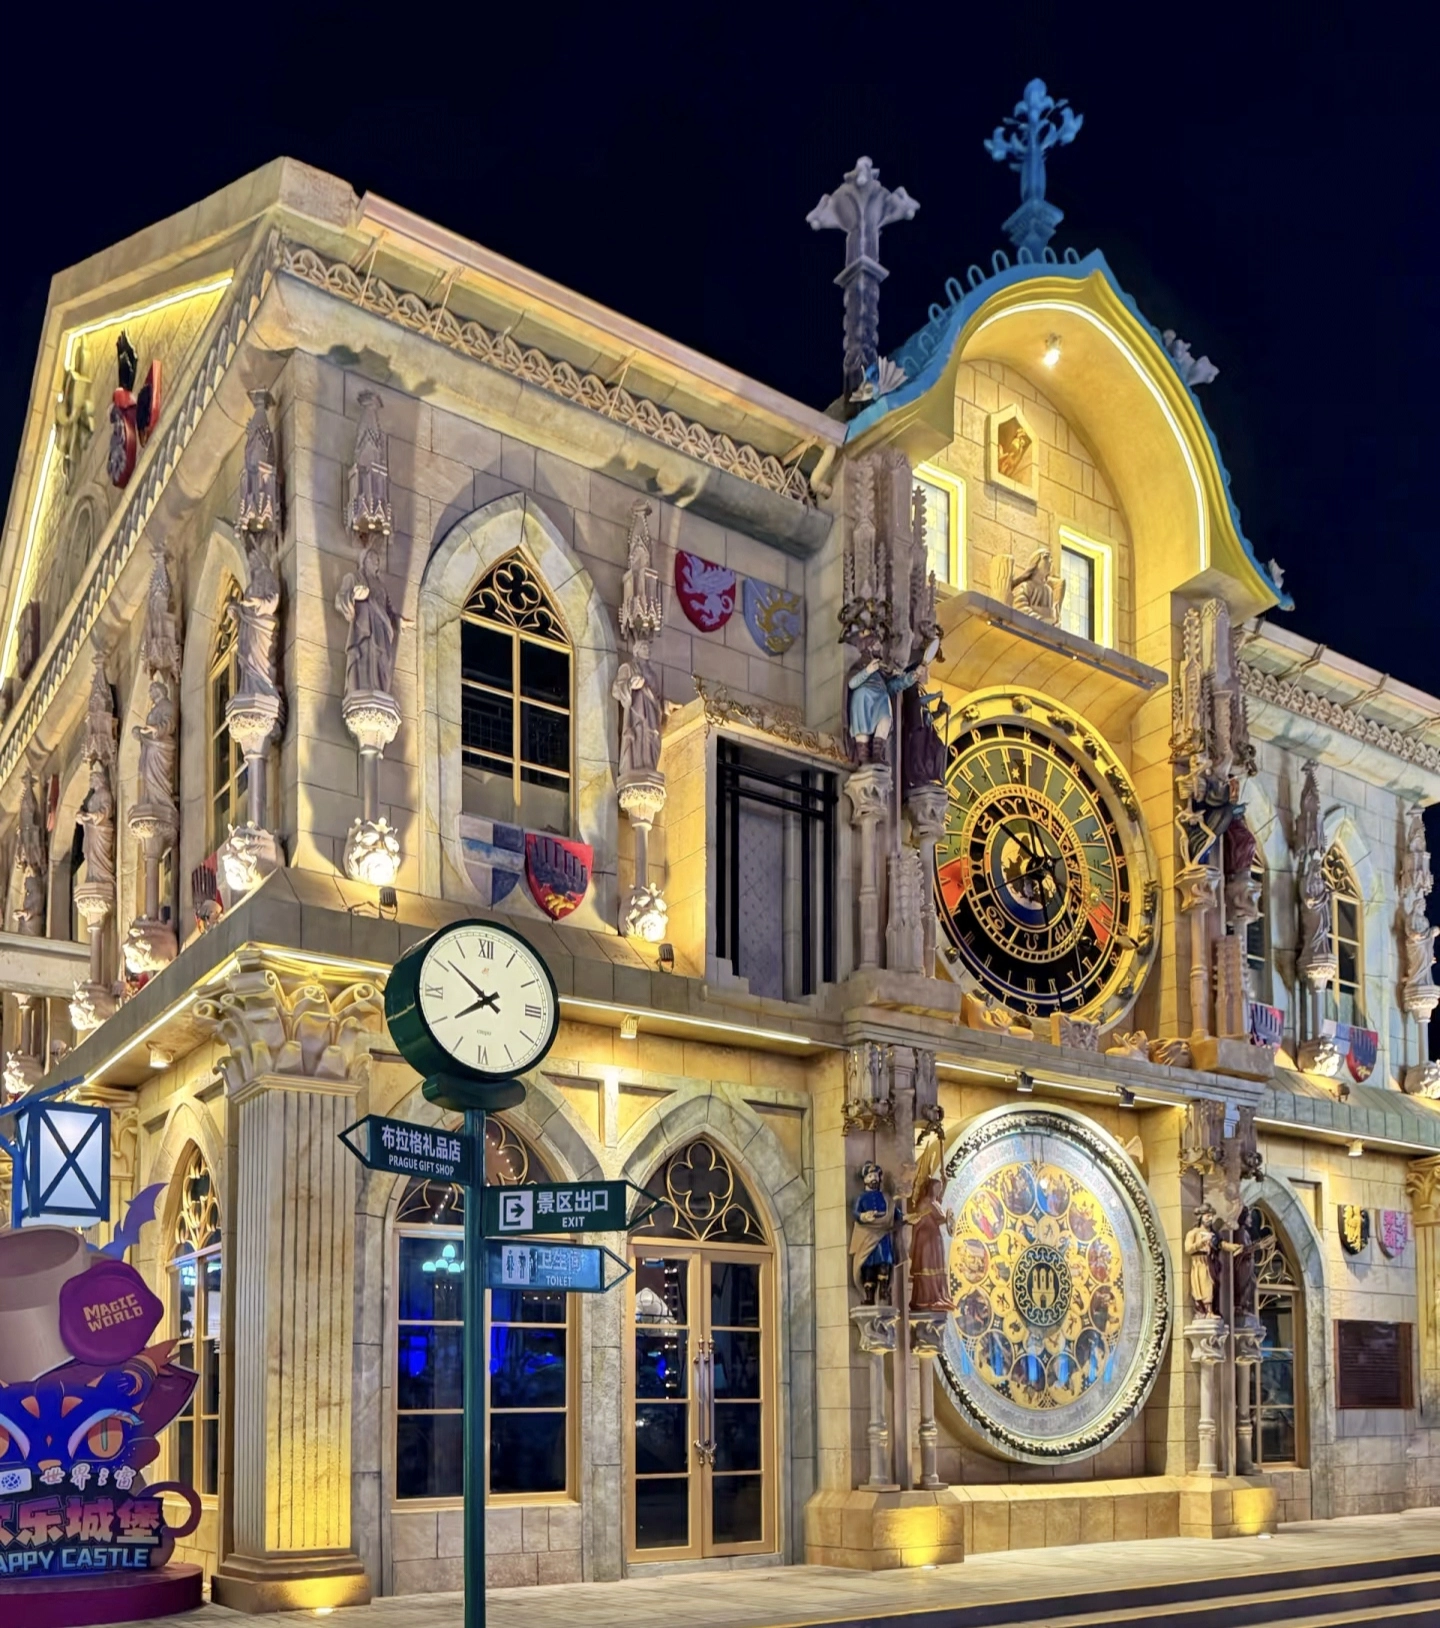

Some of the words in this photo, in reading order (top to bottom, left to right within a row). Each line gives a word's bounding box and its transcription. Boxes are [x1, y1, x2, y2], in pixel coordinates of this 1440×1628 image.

[478, 938, 494, 960] XII
[425, 983, 444, 1000] IX
[524, 1003, 542, 1019] III
[477, 1044, 490, 1066] VI
[381, 1124, 462, 1163] 布拉格礼品店
[388, 1154, 418, 1171] PRAGUE
[418, 1160, 435, 1173] GIFT
[435, 1163, 455, 1177] SHOP
[536, 1189, 609, 1214] 景区出口
[562, 1216, 585, 1228] EXIT
[545, 1275, 573, 1287] TOILET
[82, 1292, 139, 1322] MAGIC
[87, 1306, 144, 1333] WORLD
[0, 1498, 160, 1547] 乐城堡
[61, 1548, 149, 1569] CASTLE
